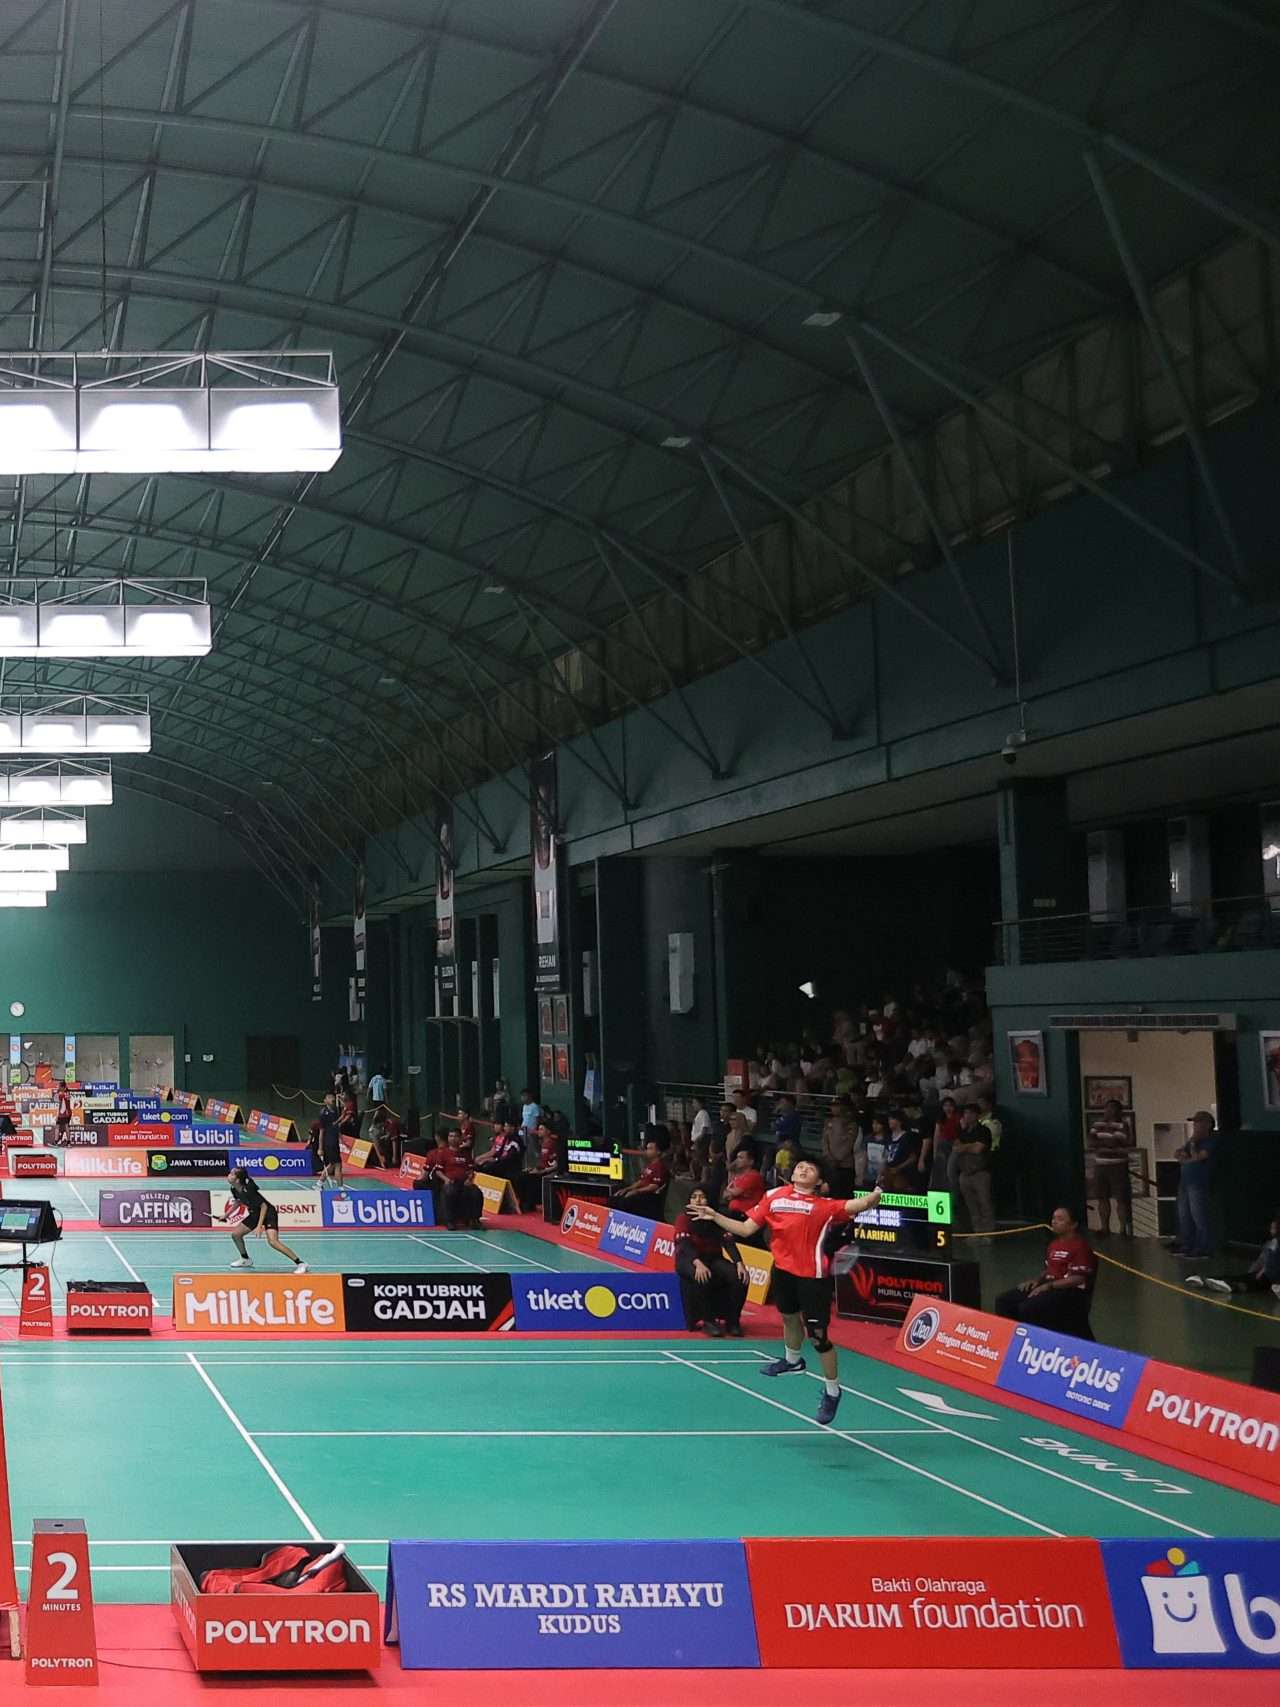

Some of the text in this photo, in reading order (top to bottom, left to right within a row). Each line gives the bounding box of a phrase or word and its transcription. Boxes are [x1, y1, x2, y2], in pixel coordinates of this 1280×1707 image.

[195, 1130, 233, 1144] blibli
[613, 1143, 619, 1154] 2
[140, 1193, 170, 1201] DELIZIO
[119, 1201, 193, 1224] CAFFINO
[277, 1205, 317, 1214] ISSANT
[358, 1199, 424, 1223] blibli
[935, 1201, 945, 1216] 6
[608, 1218, 648, 1244] hydroplus
[867, 1230, 896, 1242] ARIFAH
[936, 1231, 945, 1247] 5
[654, 1237, 676, 1257] POLY
[29, 1273, 45, 1296] 2
[373, 1284, 484, 1298] KOPI TUBRUK
[877, 1275, 945, 1292] POLYTRON
[877, 1289, 902, 1297] MURIA
[71, 1305, 149, 1317] POLYTRON
[185, 1289, 336, 1326] MilkLife
[373, 1299, 487, 1321] GADJAH
[911, 1318, 931, 1340] Cleo
[954, 1322, 991, 1342] Air Murni
[960, 1340, 976, 1353] dan
[976, 1344, 999, 1361] Sehat
[1017, 1338, 1121, 1393] hydroplus
[1145, 1389, 1280, 1452] POLYTRON
[46, 1551, 79, 1600] 2
[427, 1582, 724, 1608] RS MARDI RAHAYU
[871, 1577, 987, 1596] Bakti Olahraga
[42, 1603, 82, 1611] MINUTES
[784, 1597, 1085, 1632] DJARUM foundation
[205, 1618, 371, 1645] POLYTRON
[537, 1614, 621, 1634] KUDUS
[31, 1657, 93, 1668] POLYTRON
